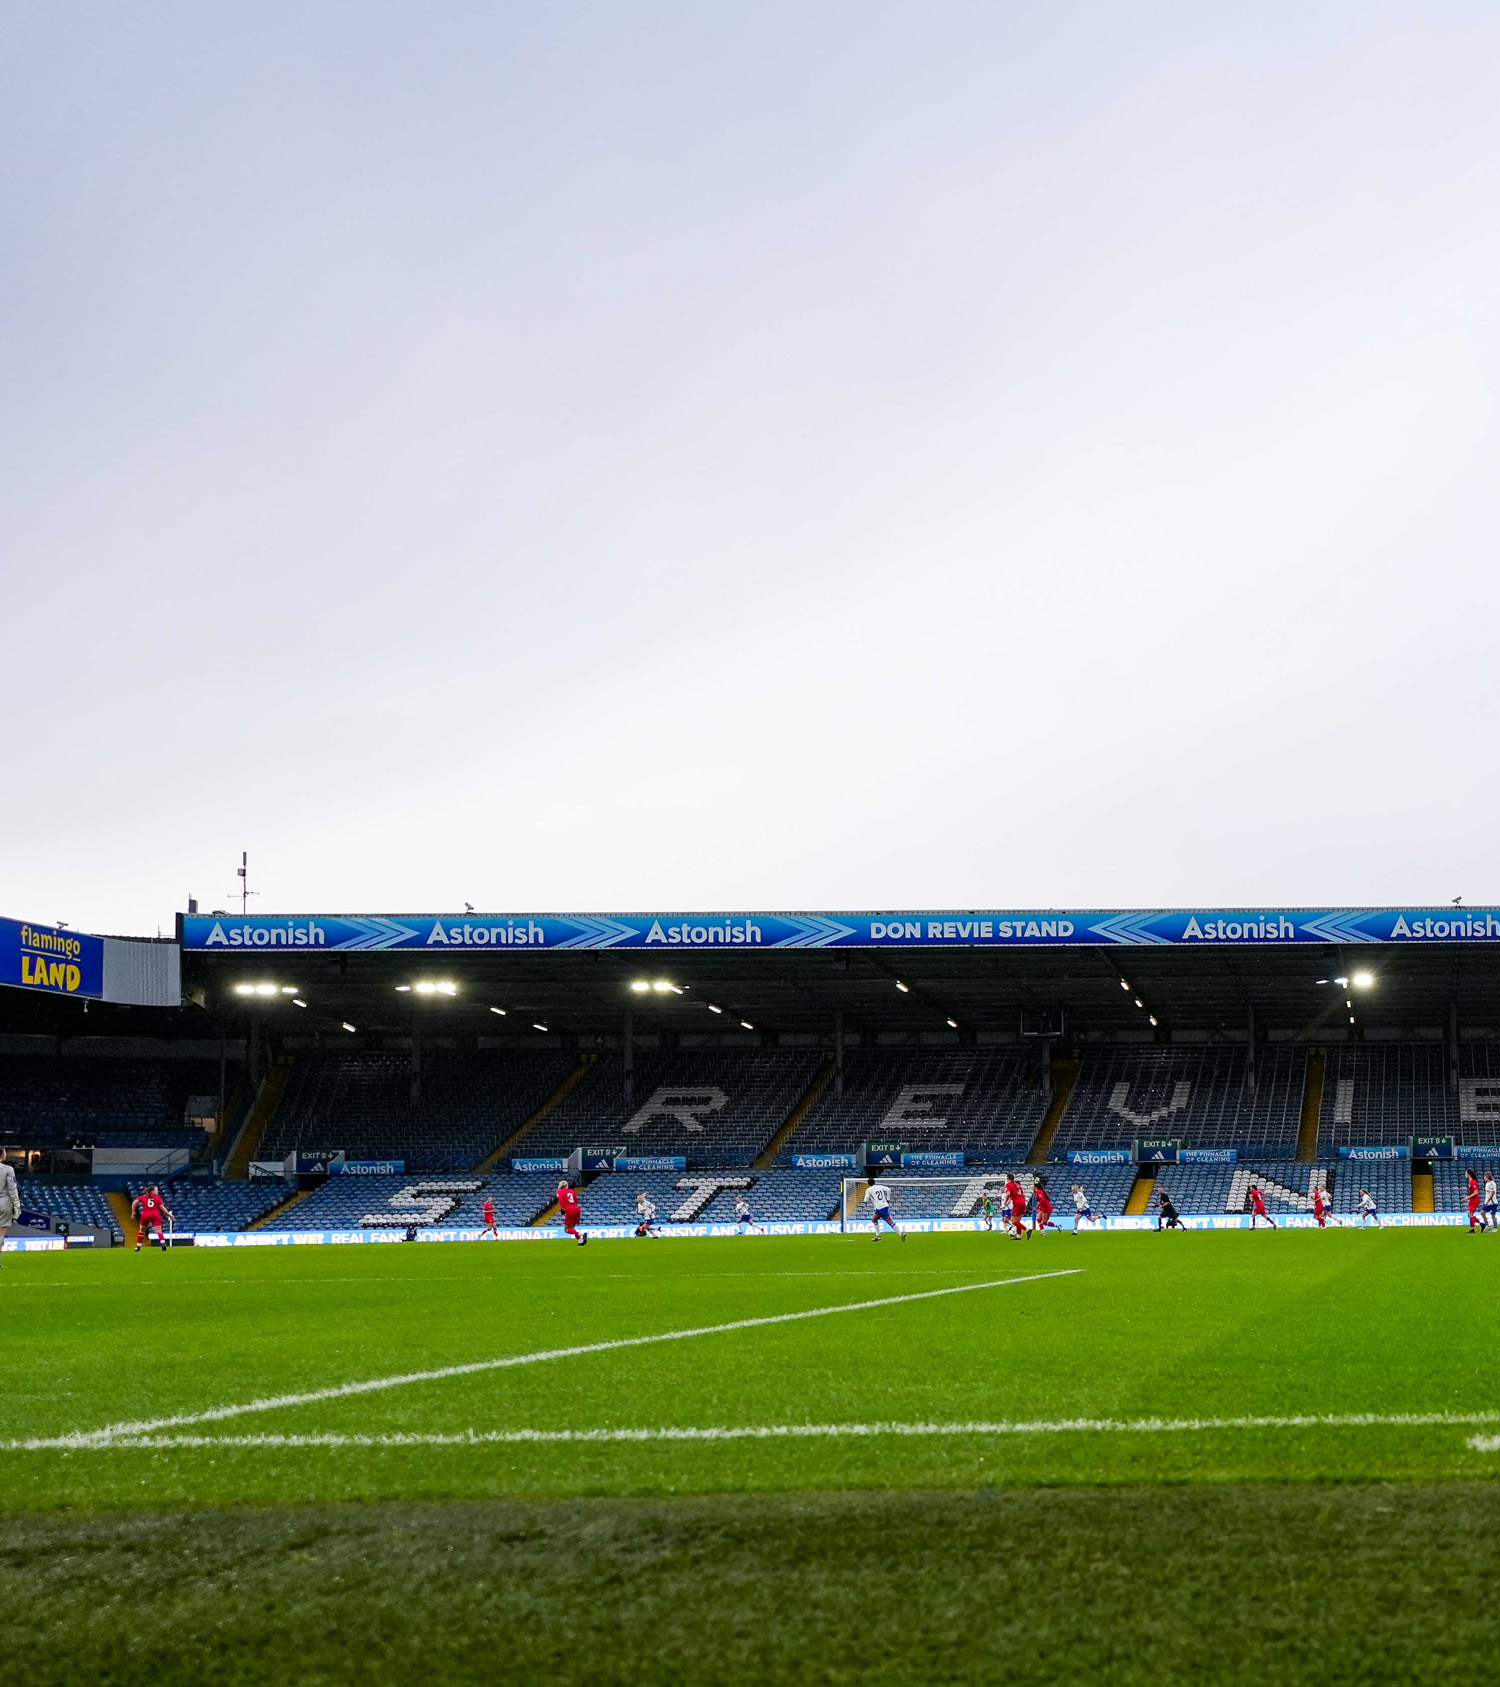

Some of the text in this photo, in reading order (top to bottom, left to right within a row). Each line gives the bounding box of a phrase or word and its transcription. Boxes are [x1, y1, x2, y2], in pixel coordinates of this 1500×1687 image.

[205, 921, 324, 945] Astonish
[427, 920, 544, 945] Astonish
[645, 919, 762, 944] Astonish
[871, 920, 1074, 938] DON REVIE STAND
[1182, 916, 1294, 939] Astonish
[1390, 913, 1500, 937] Astonish
[21, 925, 80, 959] flamingo
[22, 956, 81, 991] LAND
[796, 1156, 848, 1167] Astonish
[1073, 1153, 1124, 1164] Astonish
[1349, 1148, 1399, 1159] Astonish
[341, 1163, 394, 1174] Astonish
[514, 1161, 562, 1172] Astonish
[147, 1200, 154, 1208] 6
[567, 1193, 575, 1203] 3
[875, 1191, 884, 1201] 21
[235, 1234, 290, 1246] AREN'T
[293, 1234, 325, 1245] WE?
[331, 1233, 364, 1244] REAL
[371, 1232, 407, 1243] FANS
[710, 1225, 740, 1236] AND
[899, 1221, 930, 1232] TEXT
[933, 1220, 975, 1231] LEEDS
[1077, 1218, 1103, 1230] ALL
[1213, 1217, 1242, 1228] WE?
[1371, 1215, 1463, 1226] DISCRIMINATE
